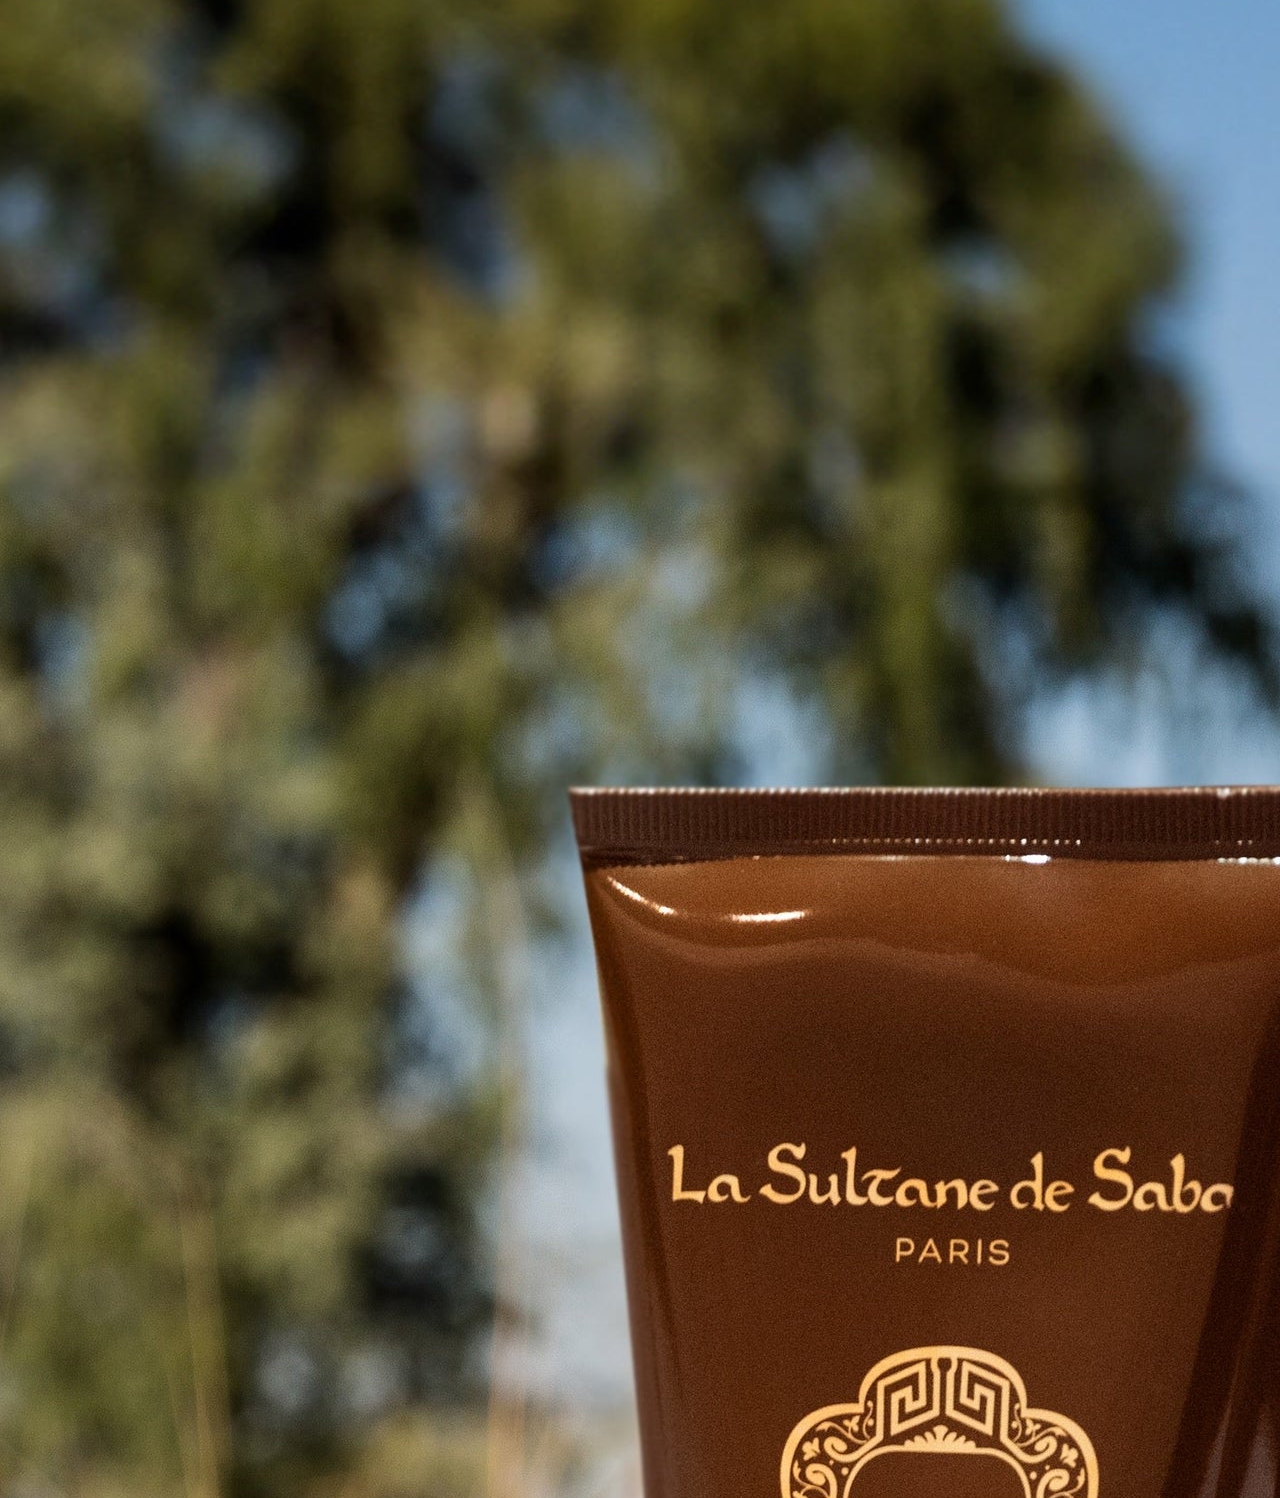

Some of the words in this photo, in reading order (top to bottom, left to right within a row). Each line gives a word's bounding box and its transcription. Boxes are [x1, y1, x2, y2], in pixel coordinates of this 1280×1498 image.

[667, 1144, 751, 1205] La
[758, 1142, 999, 1212] Sultane
[1009, 1151, 1075, 1213] de
[1087, 1145, 1234, 1214] Saba
[895, 1237, 1010, 1266] PARIS
